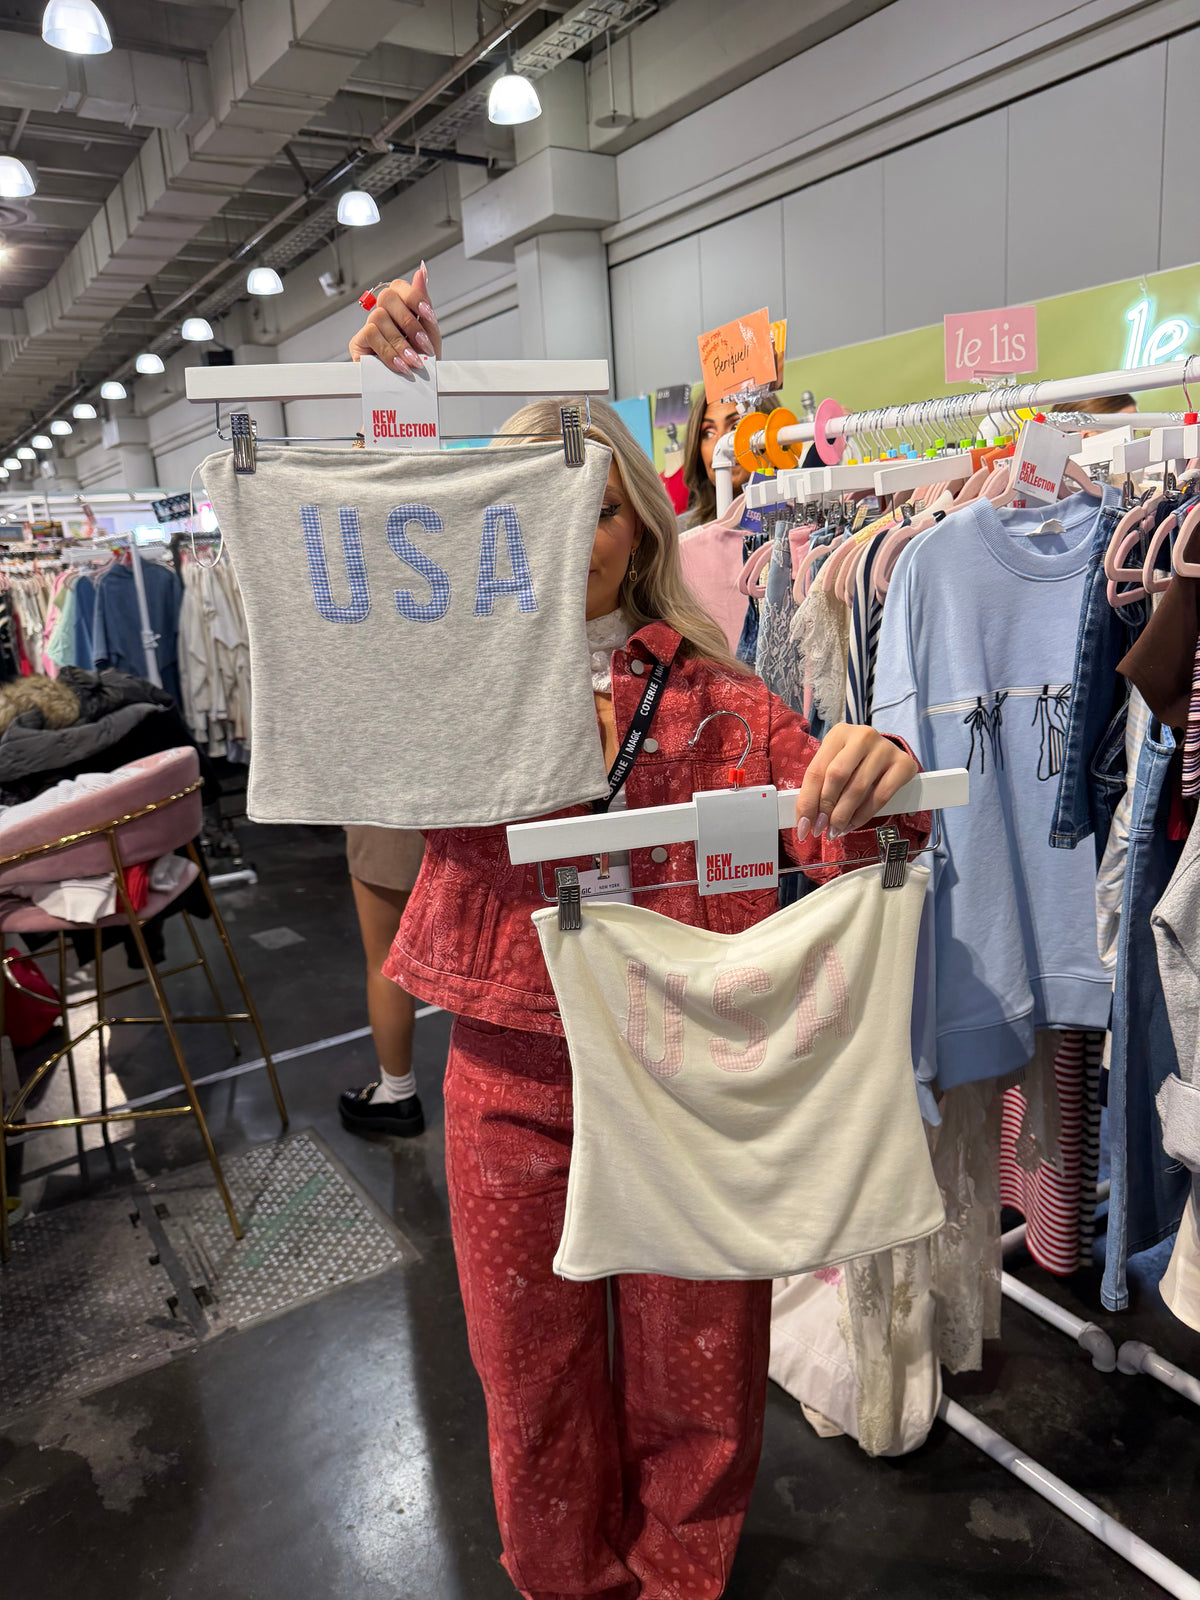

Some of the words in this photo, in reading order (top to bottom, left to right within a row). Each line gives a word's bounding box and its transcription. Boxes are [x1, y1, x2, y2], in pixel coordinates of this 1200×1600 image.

[955, 327, 982, 369] le
[990, 322, 1026, 365] lis
[1124, 298, 1189, 370] le
[372, 410, 397, 424] NEW
[373, 423, 437, 438] COLLECTION
[1021, 461, 1037, 474] NEW
[1019, 470, 1056, 493] COLLECTION
[300, 503, 538, 624] USA
[625, 729, 642, 754] MAGIC
[640, 681, 659, 716] COTERIE
[706, 853, 732, 869] NEW
[706, 862, 773, 882] COLLECTION
[627, 939, 851, 1078] USA
